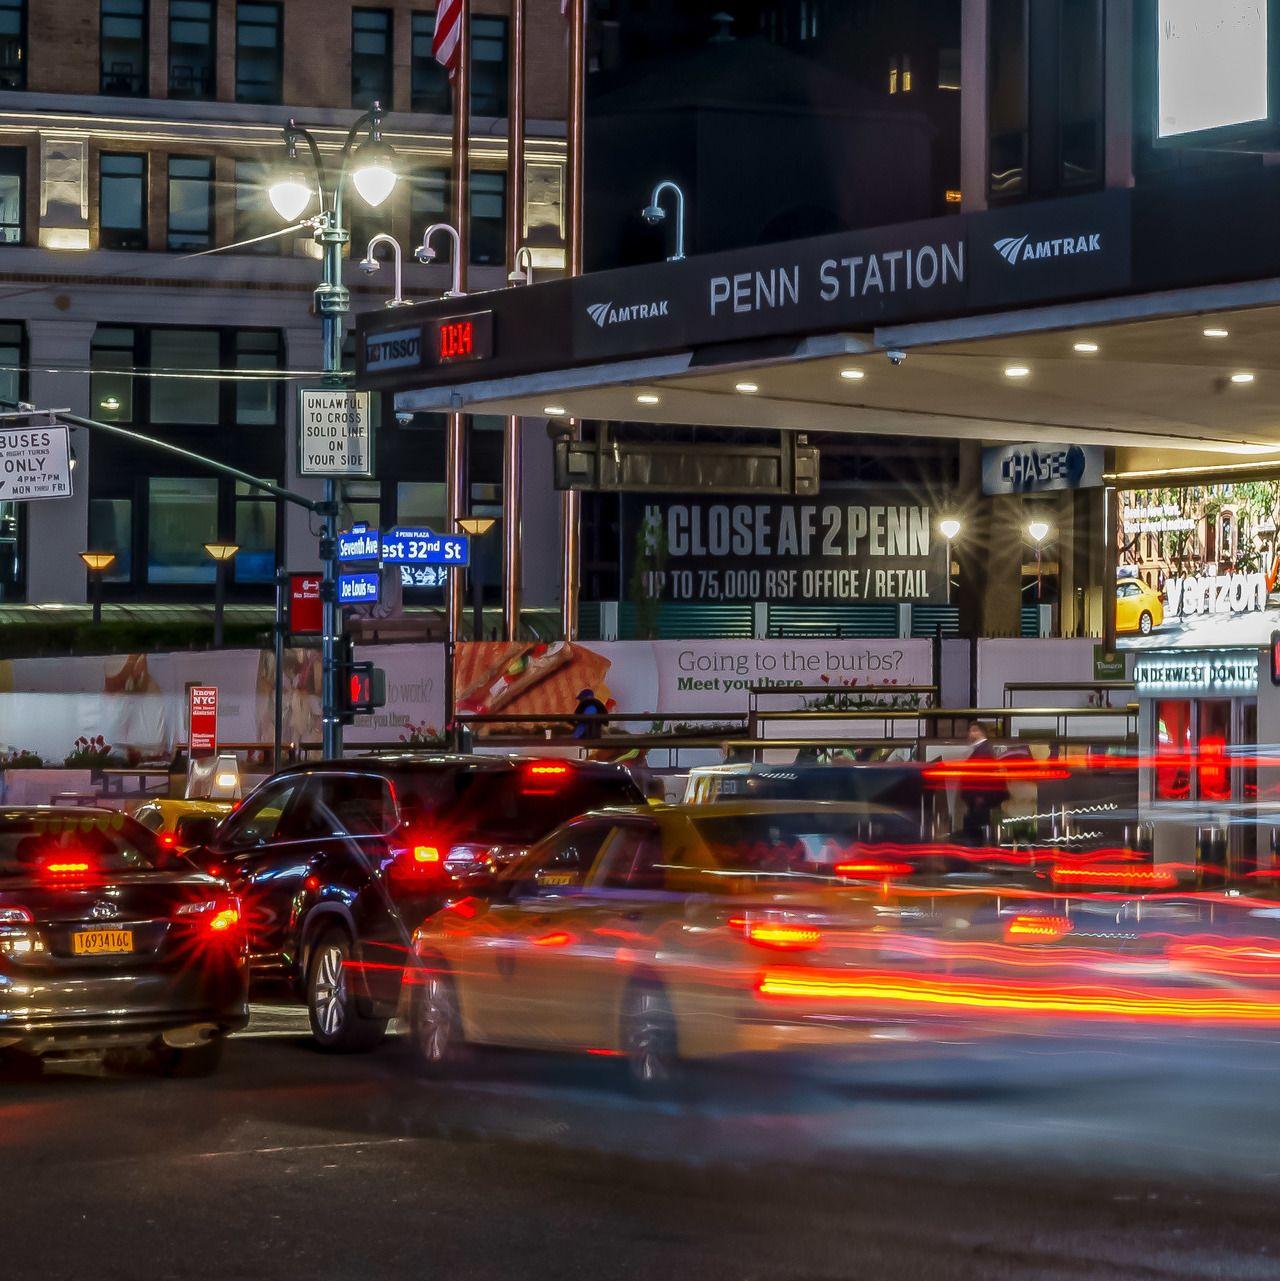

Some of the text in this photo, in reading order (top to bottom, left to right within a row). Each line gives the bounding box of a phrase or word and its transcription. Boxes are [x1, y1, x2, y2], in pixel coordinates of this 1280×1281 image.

[1023, 233, 1101, 261] AMTRAK
[710, 241, 965, 316] PENN STATION
[609, 300, 669, 324] AMTRAK
[382, 337, 420, 361] TISSOT
[308, 399, 363, 409] UNLAWFUL
[310, 412, 362, 423] TO CROSS
[307, 426, 365, 437] SOLID LINE
[0, 433, 51, 449] BUSES
[329, 440, 343, 451] ON
[4, 457, 46, 473] ONLY
[308, 455, 364, 466] YOUR SIDE
[12, 483, 66, 495] MON FRI
[848, 505, 931, 556] PENN
[340, 536, 378, 556] Seventh Ave
[382, 540, 462, 559] est 32nd St
[342, 580, 352, 597] Joe
[352, 577, 367, 596] Louis
[673, 570, 693, 598] TO
[699, 570, 760, 601] 75,000
[765, 570, 797, 598] RSF
[802, 570, 859, 598] OFFICE
[875, 569, 930, 598] RETAIL
[678, 650, 904, 675] Going to the burbs?
[401, 679, 434, 705] work?
[677, 677, 719, 691] Meet
[722, 679, 751, 694] you
[193, 697, 215, 705] NYC
[80, 932, 129, 949] T693416C
